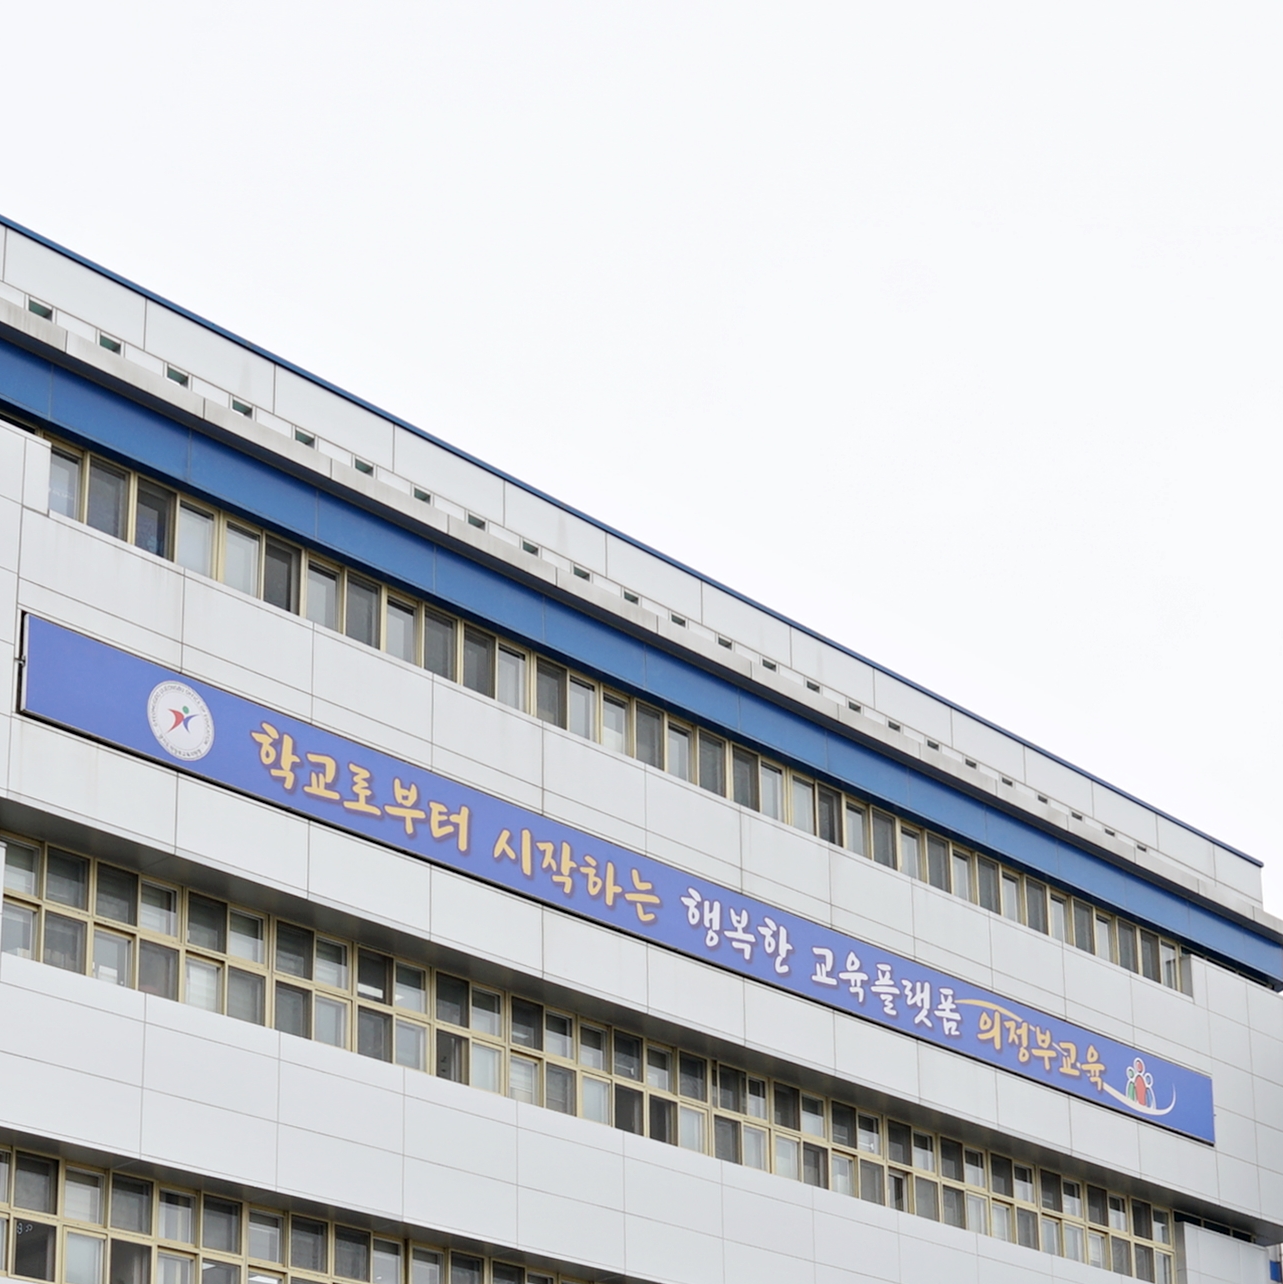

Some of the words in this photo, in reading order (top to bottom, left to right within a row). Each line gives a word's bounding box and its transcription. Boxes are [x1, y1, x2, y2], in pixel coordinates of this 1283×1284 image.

[250, 722, 470, 852] 학교로부터
[494, 829, 660, 922] 시작하는
[681, 887, 793, 973] 행복한
[812, 946, 961, 1036] 교육플랫폼
[977, 1010, 1105, 1091] 의정부교육
